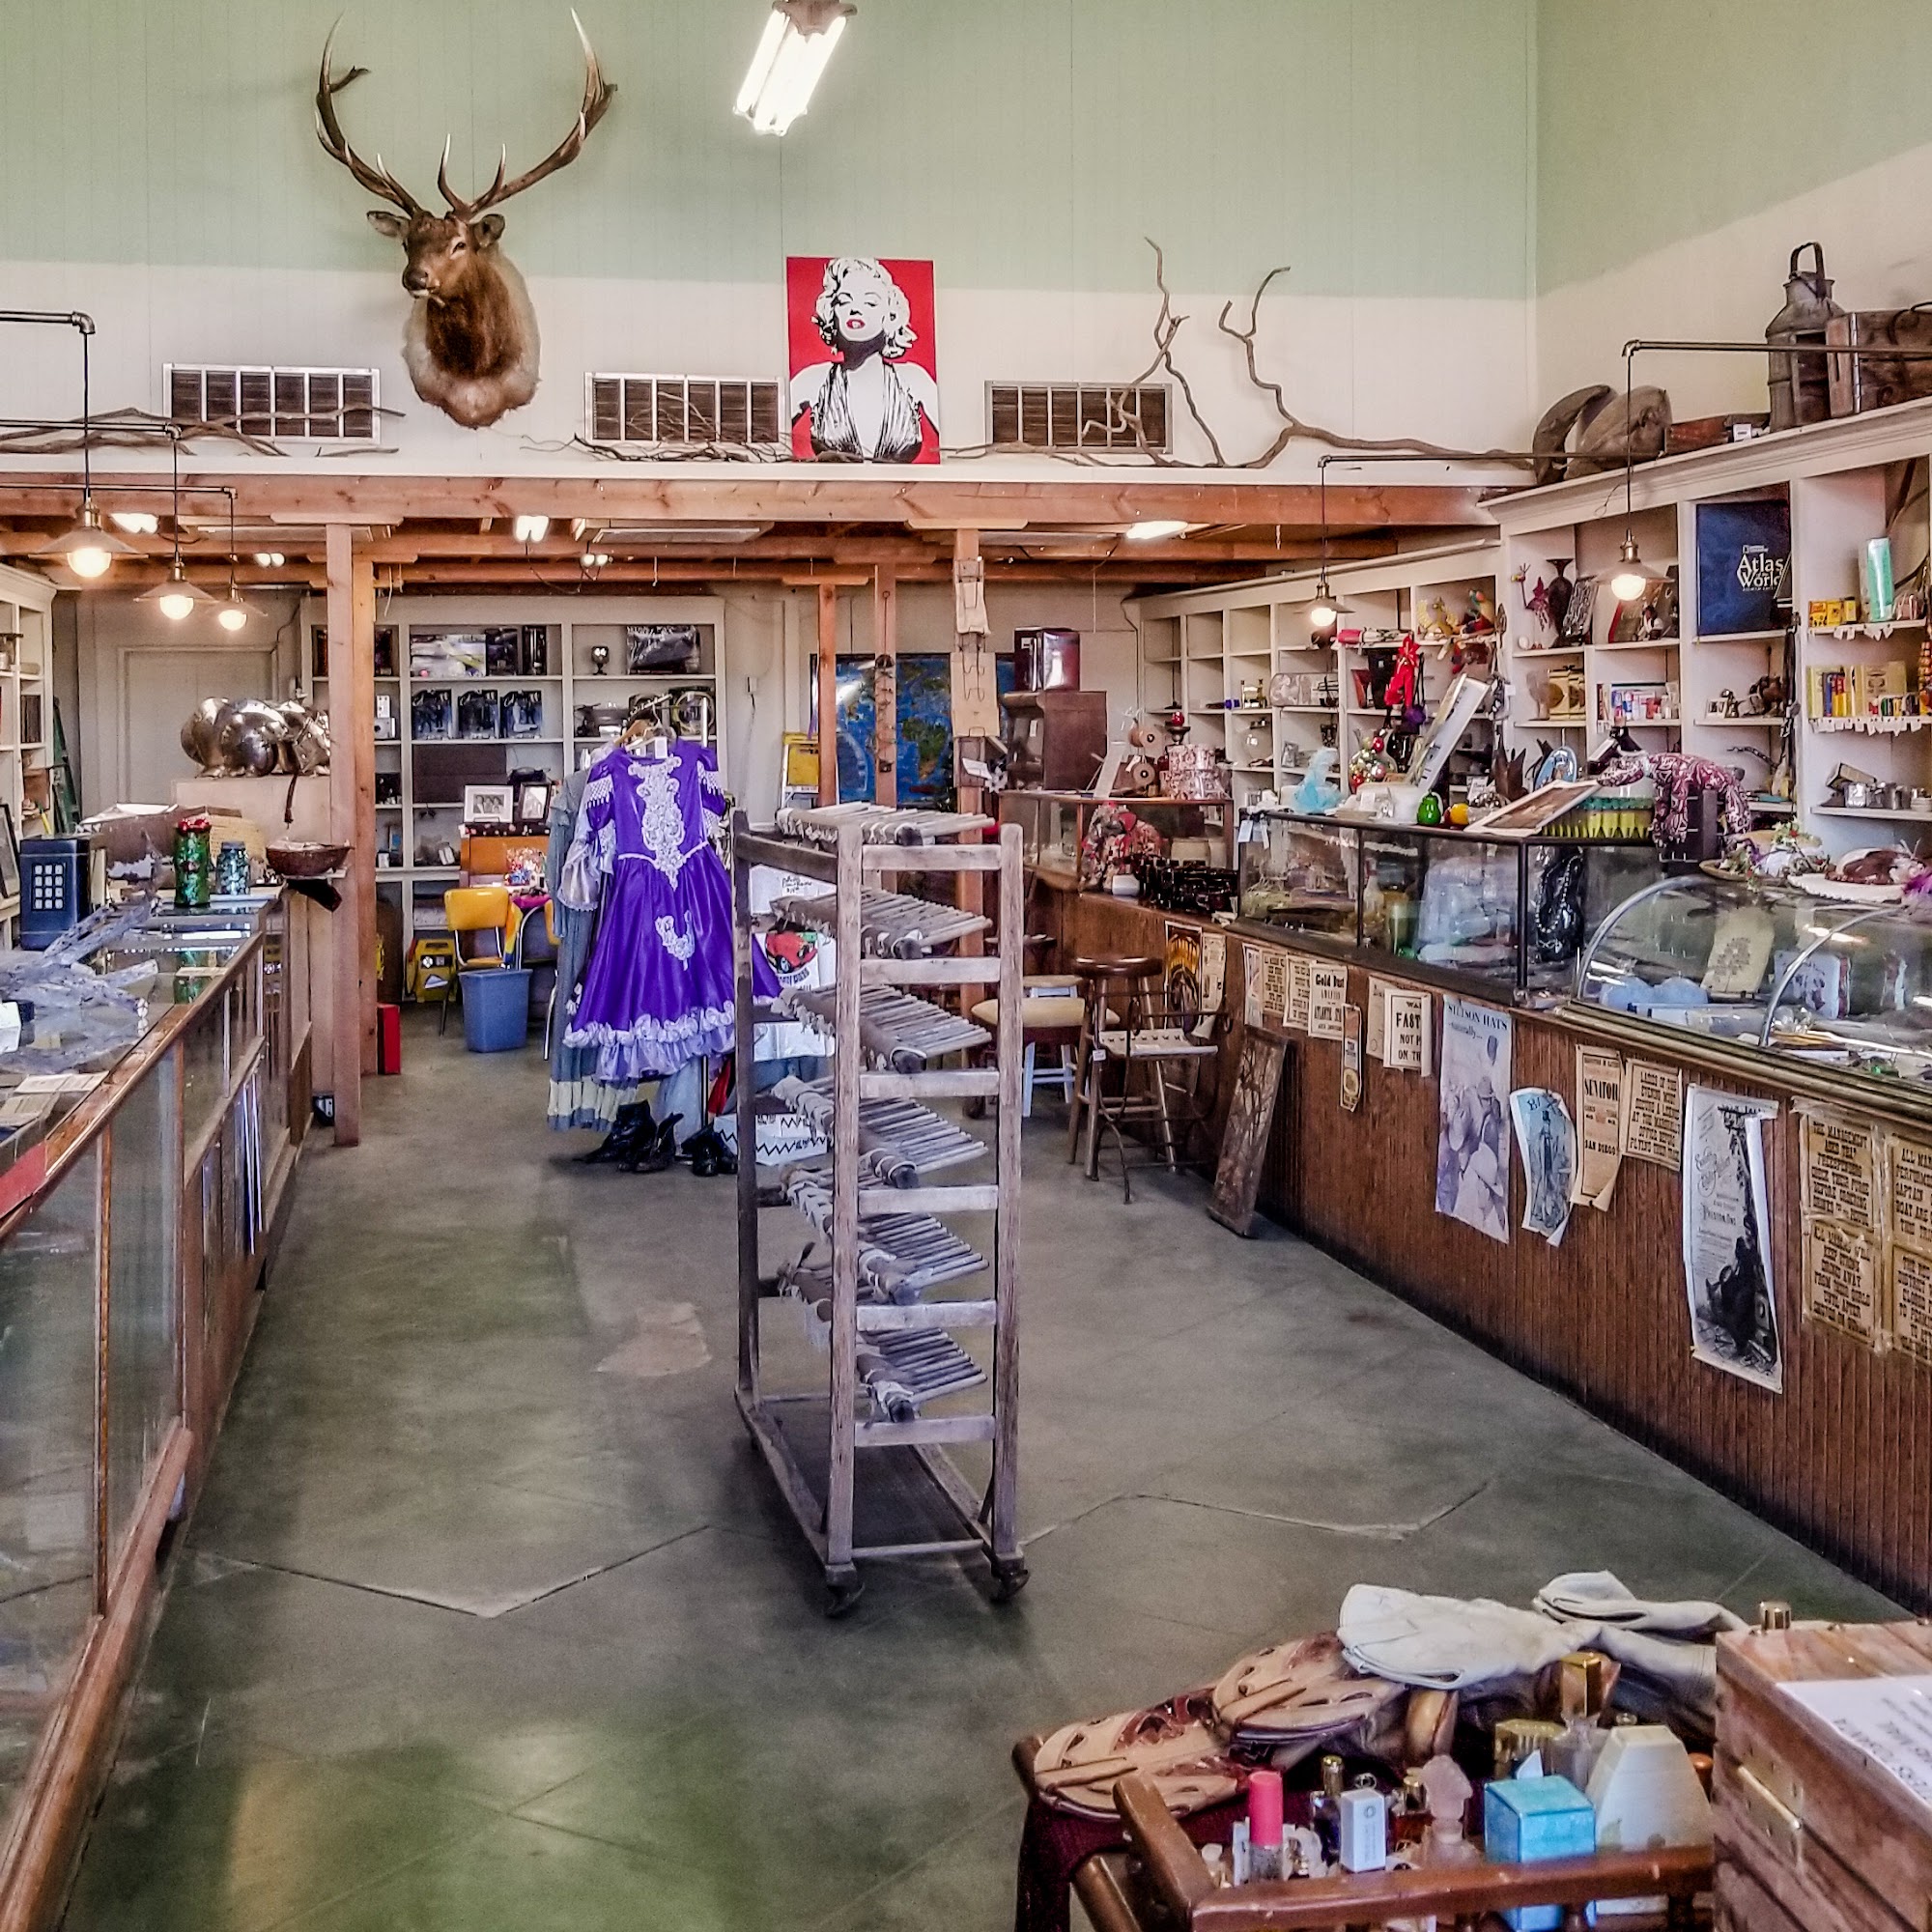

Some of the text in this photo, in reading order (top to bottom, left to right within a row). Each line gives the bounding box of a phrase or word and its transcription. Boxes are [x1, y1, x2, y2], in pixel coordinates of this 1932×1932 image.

[1738, 553, 1784, 572] Atlas
[1396, 1012, 1421, 1030] FAST
[1448, 1005, 1508, 1032] STETSON HATS
[1400, 1034, 1414, 1045] NOT
[1398, 1050, 1408, 1061] ON
[1813, 1121, 1867, 1149] THE MANAGEMENT
[1585, 1140, 1615, 1155] SAN DIEGO
[1902, 1149, 1916, 1164] ALL
[1896, 1182, 1923, 1202] CAPTAIN
[1896, 1200, 1913, 1217] BOAT
[1815, 1270, 1831, 1289] FROM
[1843, 1270, 1861, 1288] AWAY
